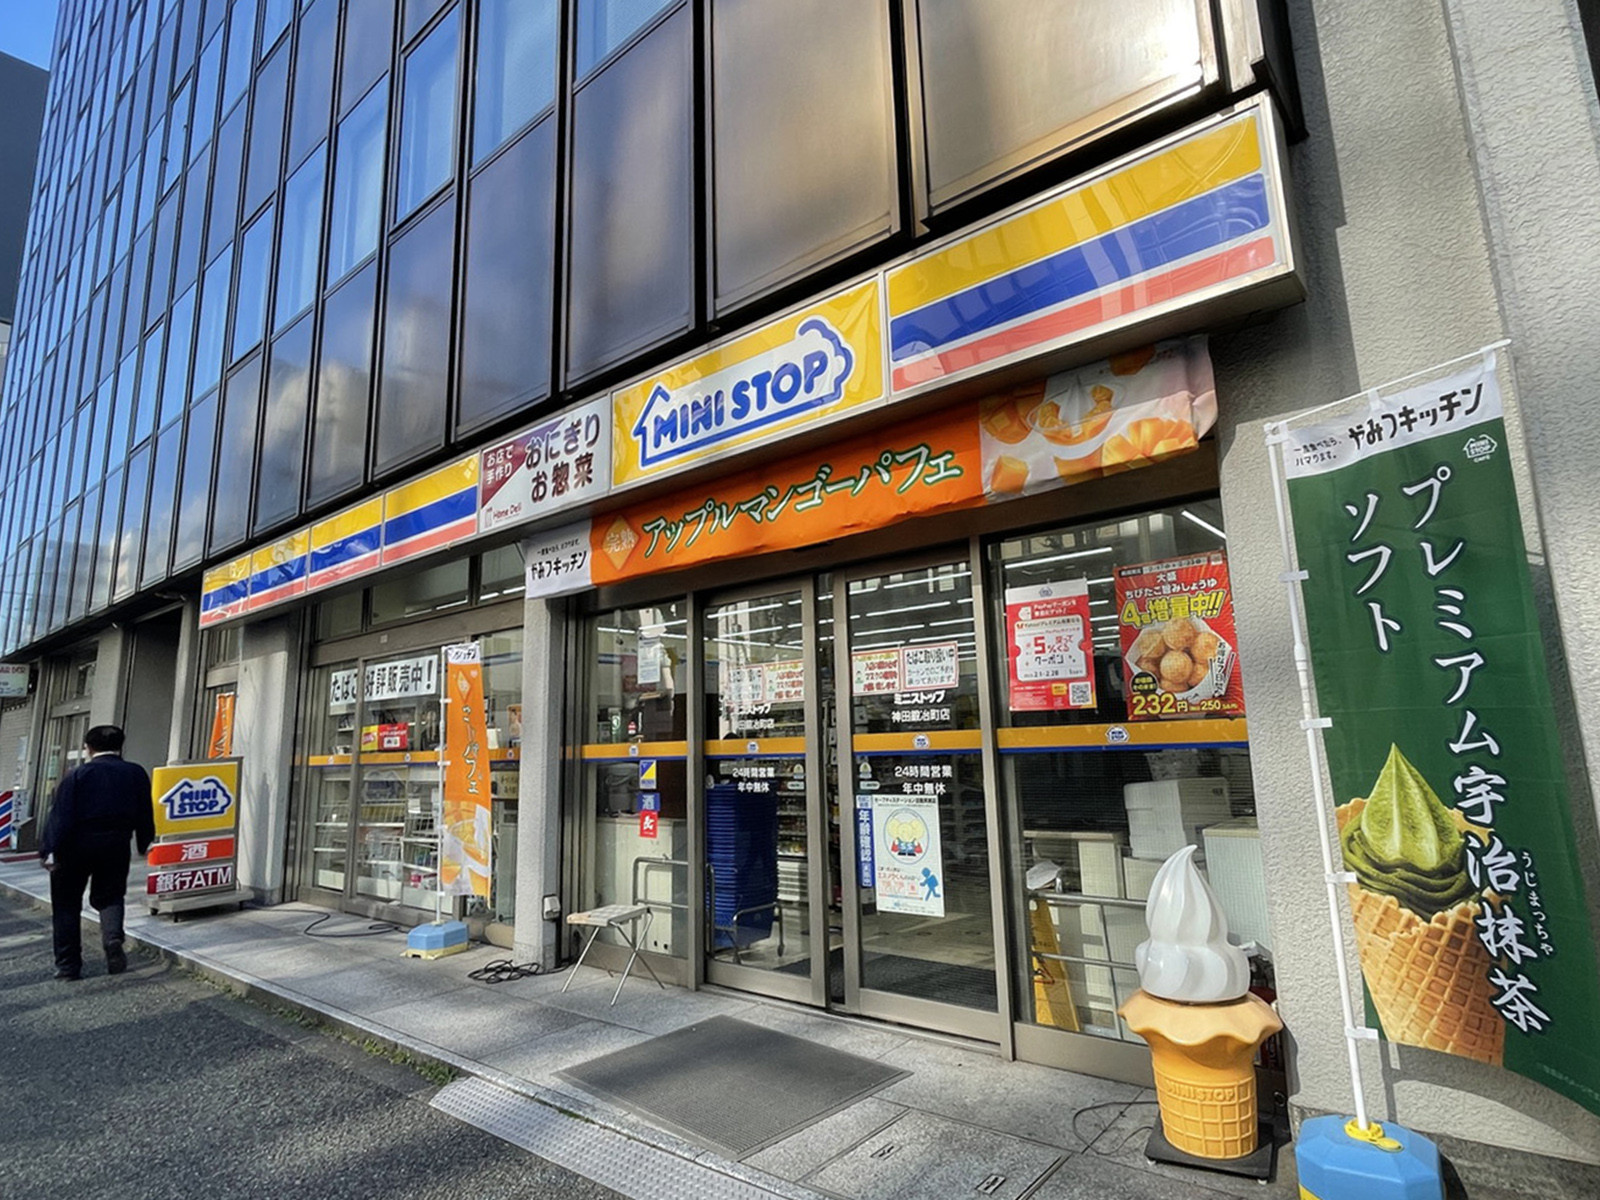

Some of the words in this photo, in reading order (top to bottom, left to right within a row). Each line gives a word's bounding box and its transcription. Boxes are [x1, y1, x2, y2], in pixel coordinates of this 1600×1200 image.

[653, 391, 725, 449] MINI
[731, 350, 828, 420] STOP
[525, 414, 600, 470] おにぎり
[487, 445, 514, 467] お店で
[486, 462, 512, 485] 手作り
[531, 452, 594, 503] お惣菜
[642, 446, 962, 558] アップルマンゴーパフェ
[1345, 494, 1401, 651] ソフト
[894, 690, 946, 705] ミニストップ
[1132, 693, 1188, 715] 232円
[1402, 466, 1551, 1032] プレミアム宇治抹茶
[732, 767, 775, 778] 24時間営業
[894, 765, 952, 778] 24時間営業
[180, 788, 218, 802] MINI
[737, 782, 770, 793] 年中無休
[902, 782, 946, 795] 年中無休
[178, 800, 219, 813] STOP
[642, 795, 655, 810] 酒
[181, 842, 209, 861] 酒
[156, 867, 232, 893] 銀行ATM
